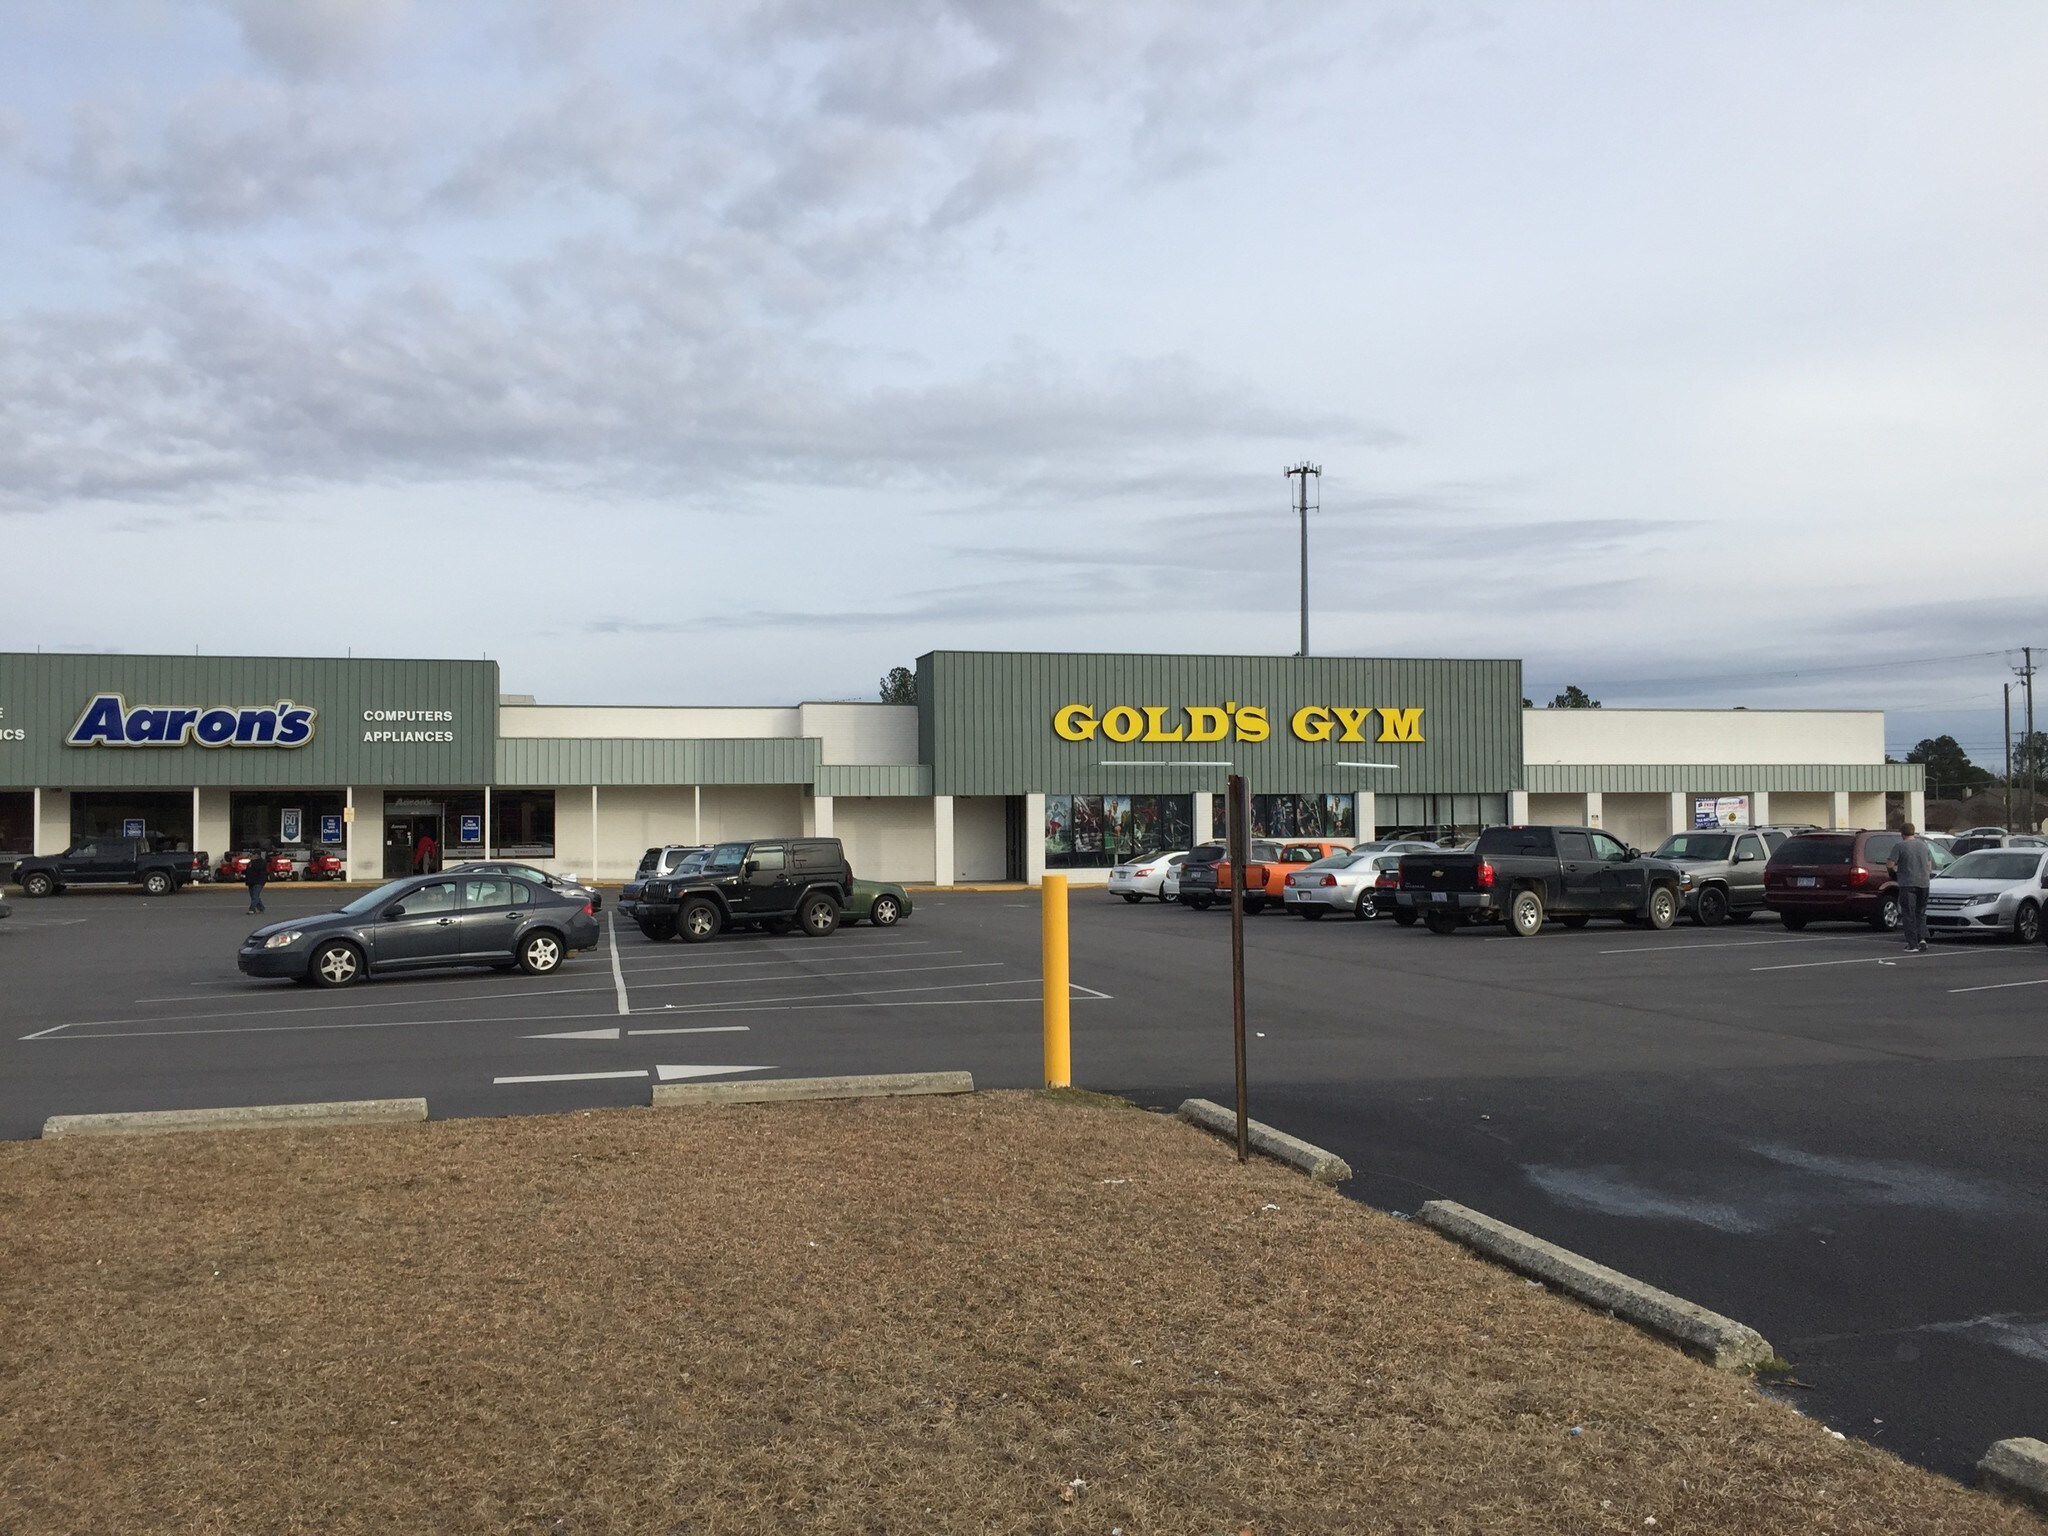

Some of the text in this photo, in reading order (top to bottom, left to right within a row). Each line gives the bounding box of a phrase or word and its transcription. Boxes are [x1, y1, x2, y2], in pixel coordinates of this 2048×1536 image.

[70, 697, 314, 744] Aaron's
[363, 710, 453, 722] COMPUTERS
[1054, 701, 1425, 743] GOLD'S GYM
[363, 730, 454, 742] APPLIANCES
